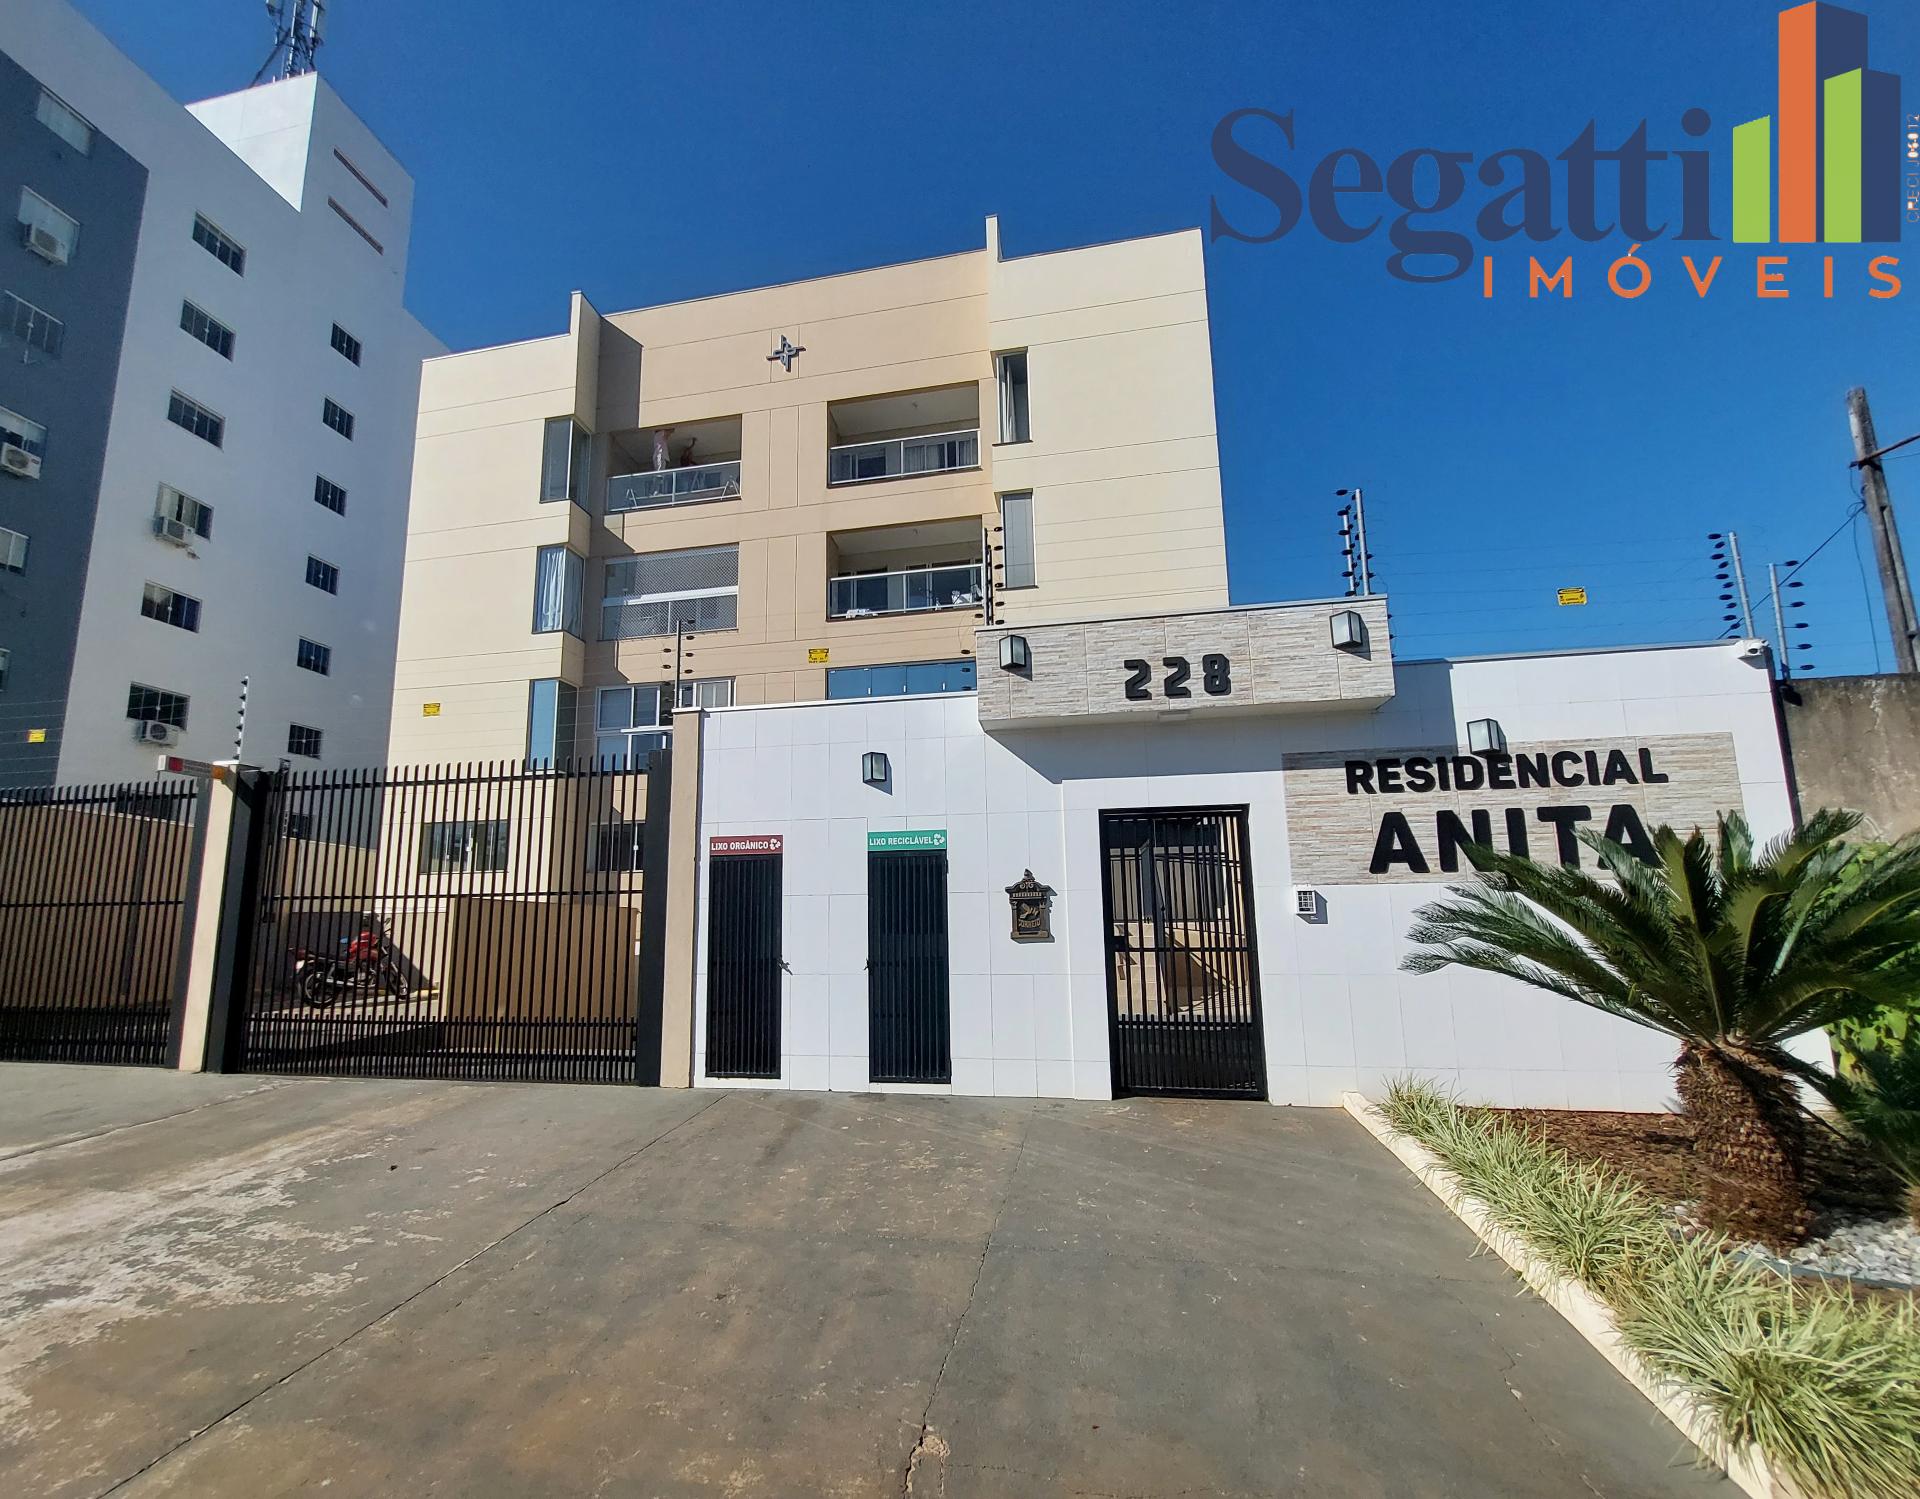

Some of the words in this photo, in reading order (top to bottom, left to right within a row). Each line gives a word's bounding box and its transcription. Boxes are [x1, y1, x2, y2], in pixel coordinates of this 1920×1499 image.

[1123, 653, 1232, 701] 228
[1344, 747, 1669, 795] RESIDENCIAL
[711, 842, 728, 851] LIXO
[730, 840, 769, 850] ORGÂNICO
[869, 837, 886, 846] LIXO
[888, 834, 933, 846] RECICLÁVEL
[1369, 804, 1663, 874] ANITA
